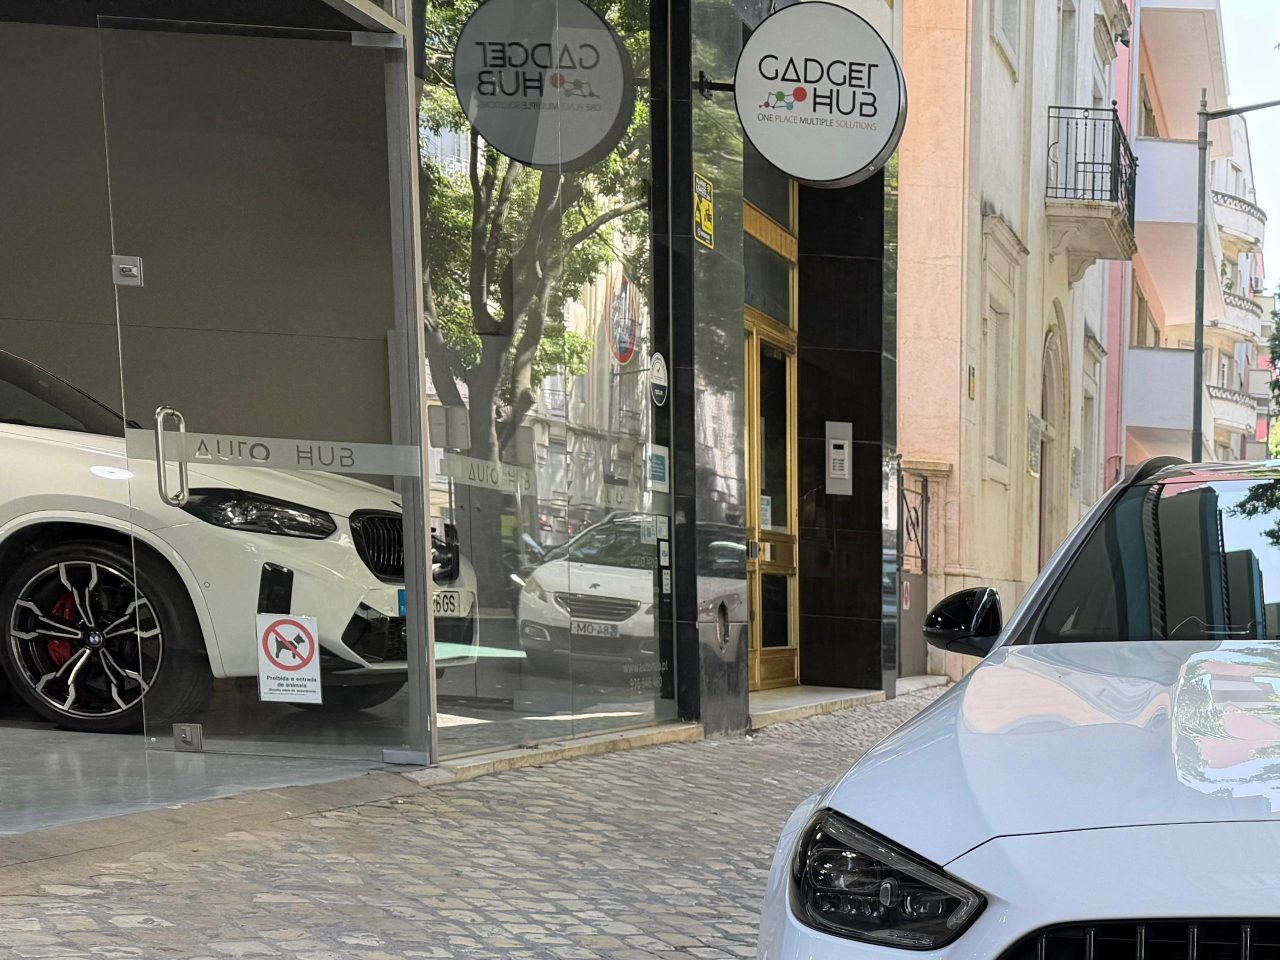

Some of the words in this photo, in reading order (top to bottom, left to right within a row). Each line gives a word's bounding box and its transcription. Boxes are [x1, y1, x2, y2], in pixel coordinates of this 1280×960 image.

[758, 54, 879, 89] GADGET
[812, 87, 878, 118] HUB
[757, 112, 773, 122] ONE
[775, 114, 798, 124] PLACE
[799, 116, 834, 127] MULTIPLE
[835, 119, 877, 131] SOLUTIONS
[195, 439, 271, 462] AUTO
[296, 445, 355, 468] HUB
[468, 463, 499, 485] AUTO
